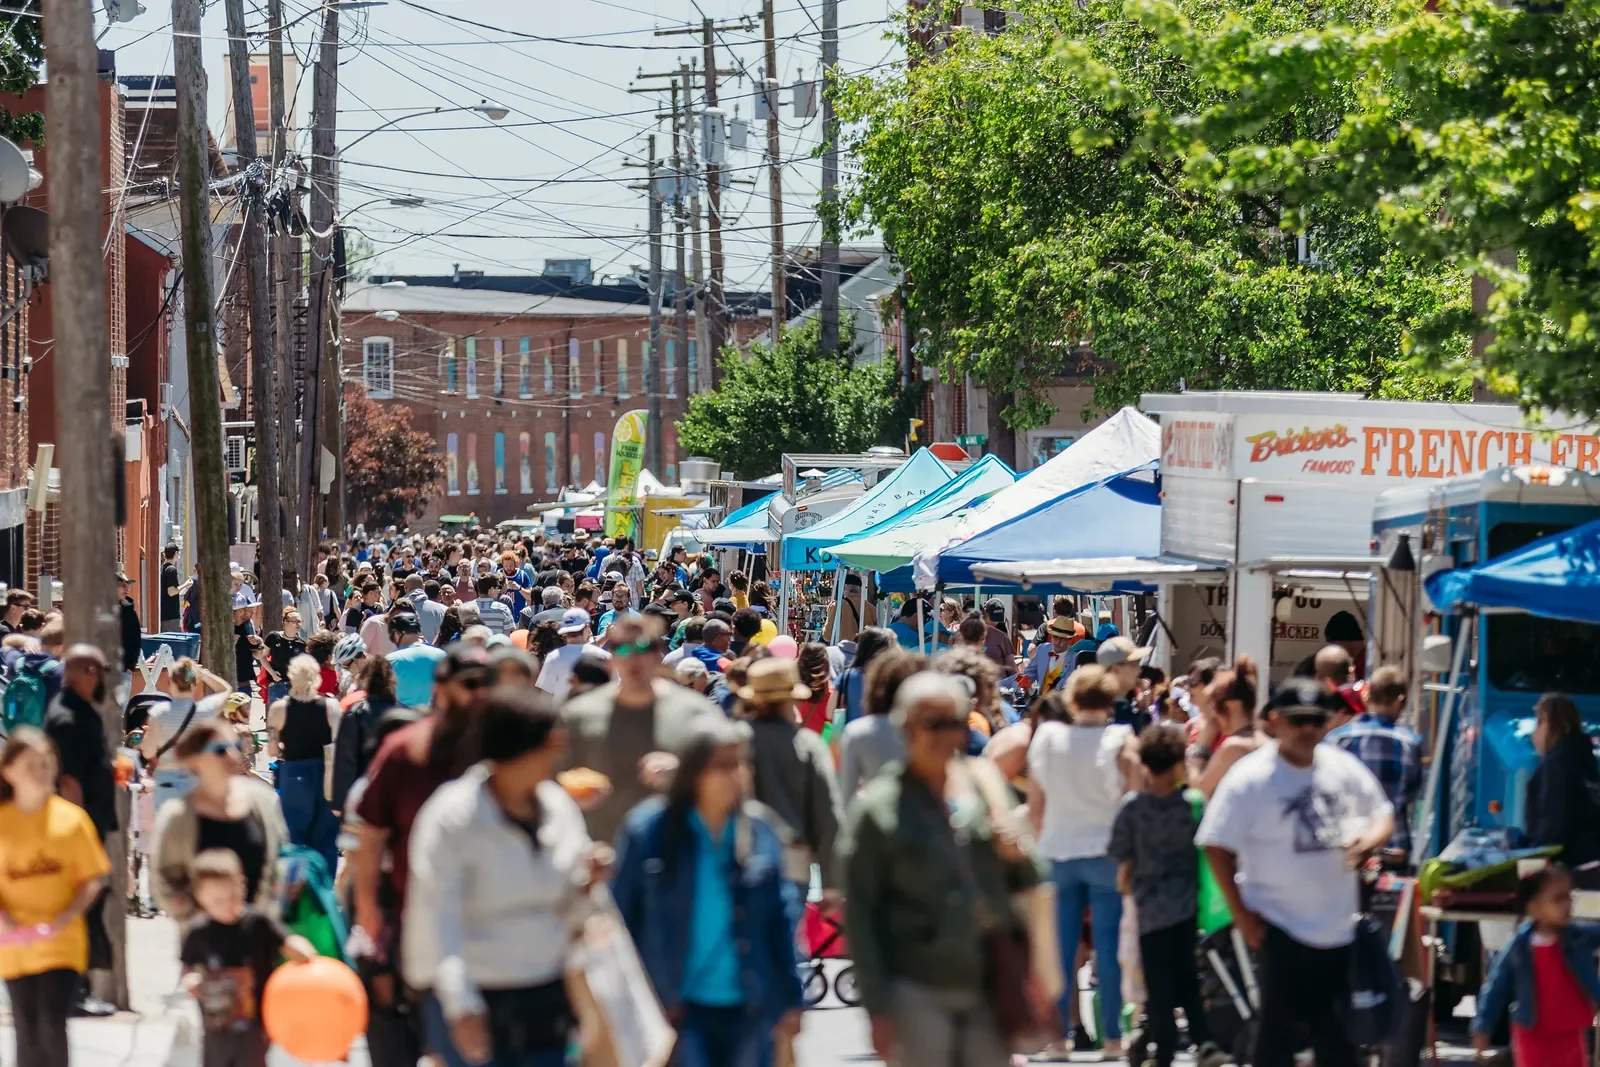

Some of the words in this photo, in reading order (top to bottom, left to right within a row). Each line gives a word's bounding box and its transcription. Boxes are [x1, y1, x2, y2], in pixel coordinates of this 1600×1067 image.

[1245, 424, 1357, 462] Bricker's
[1361, 427, 1534, 478] FRENCH
[1301, 459, 1355, 475] FAMOUS
[894, 489, 927, 500] BAR
